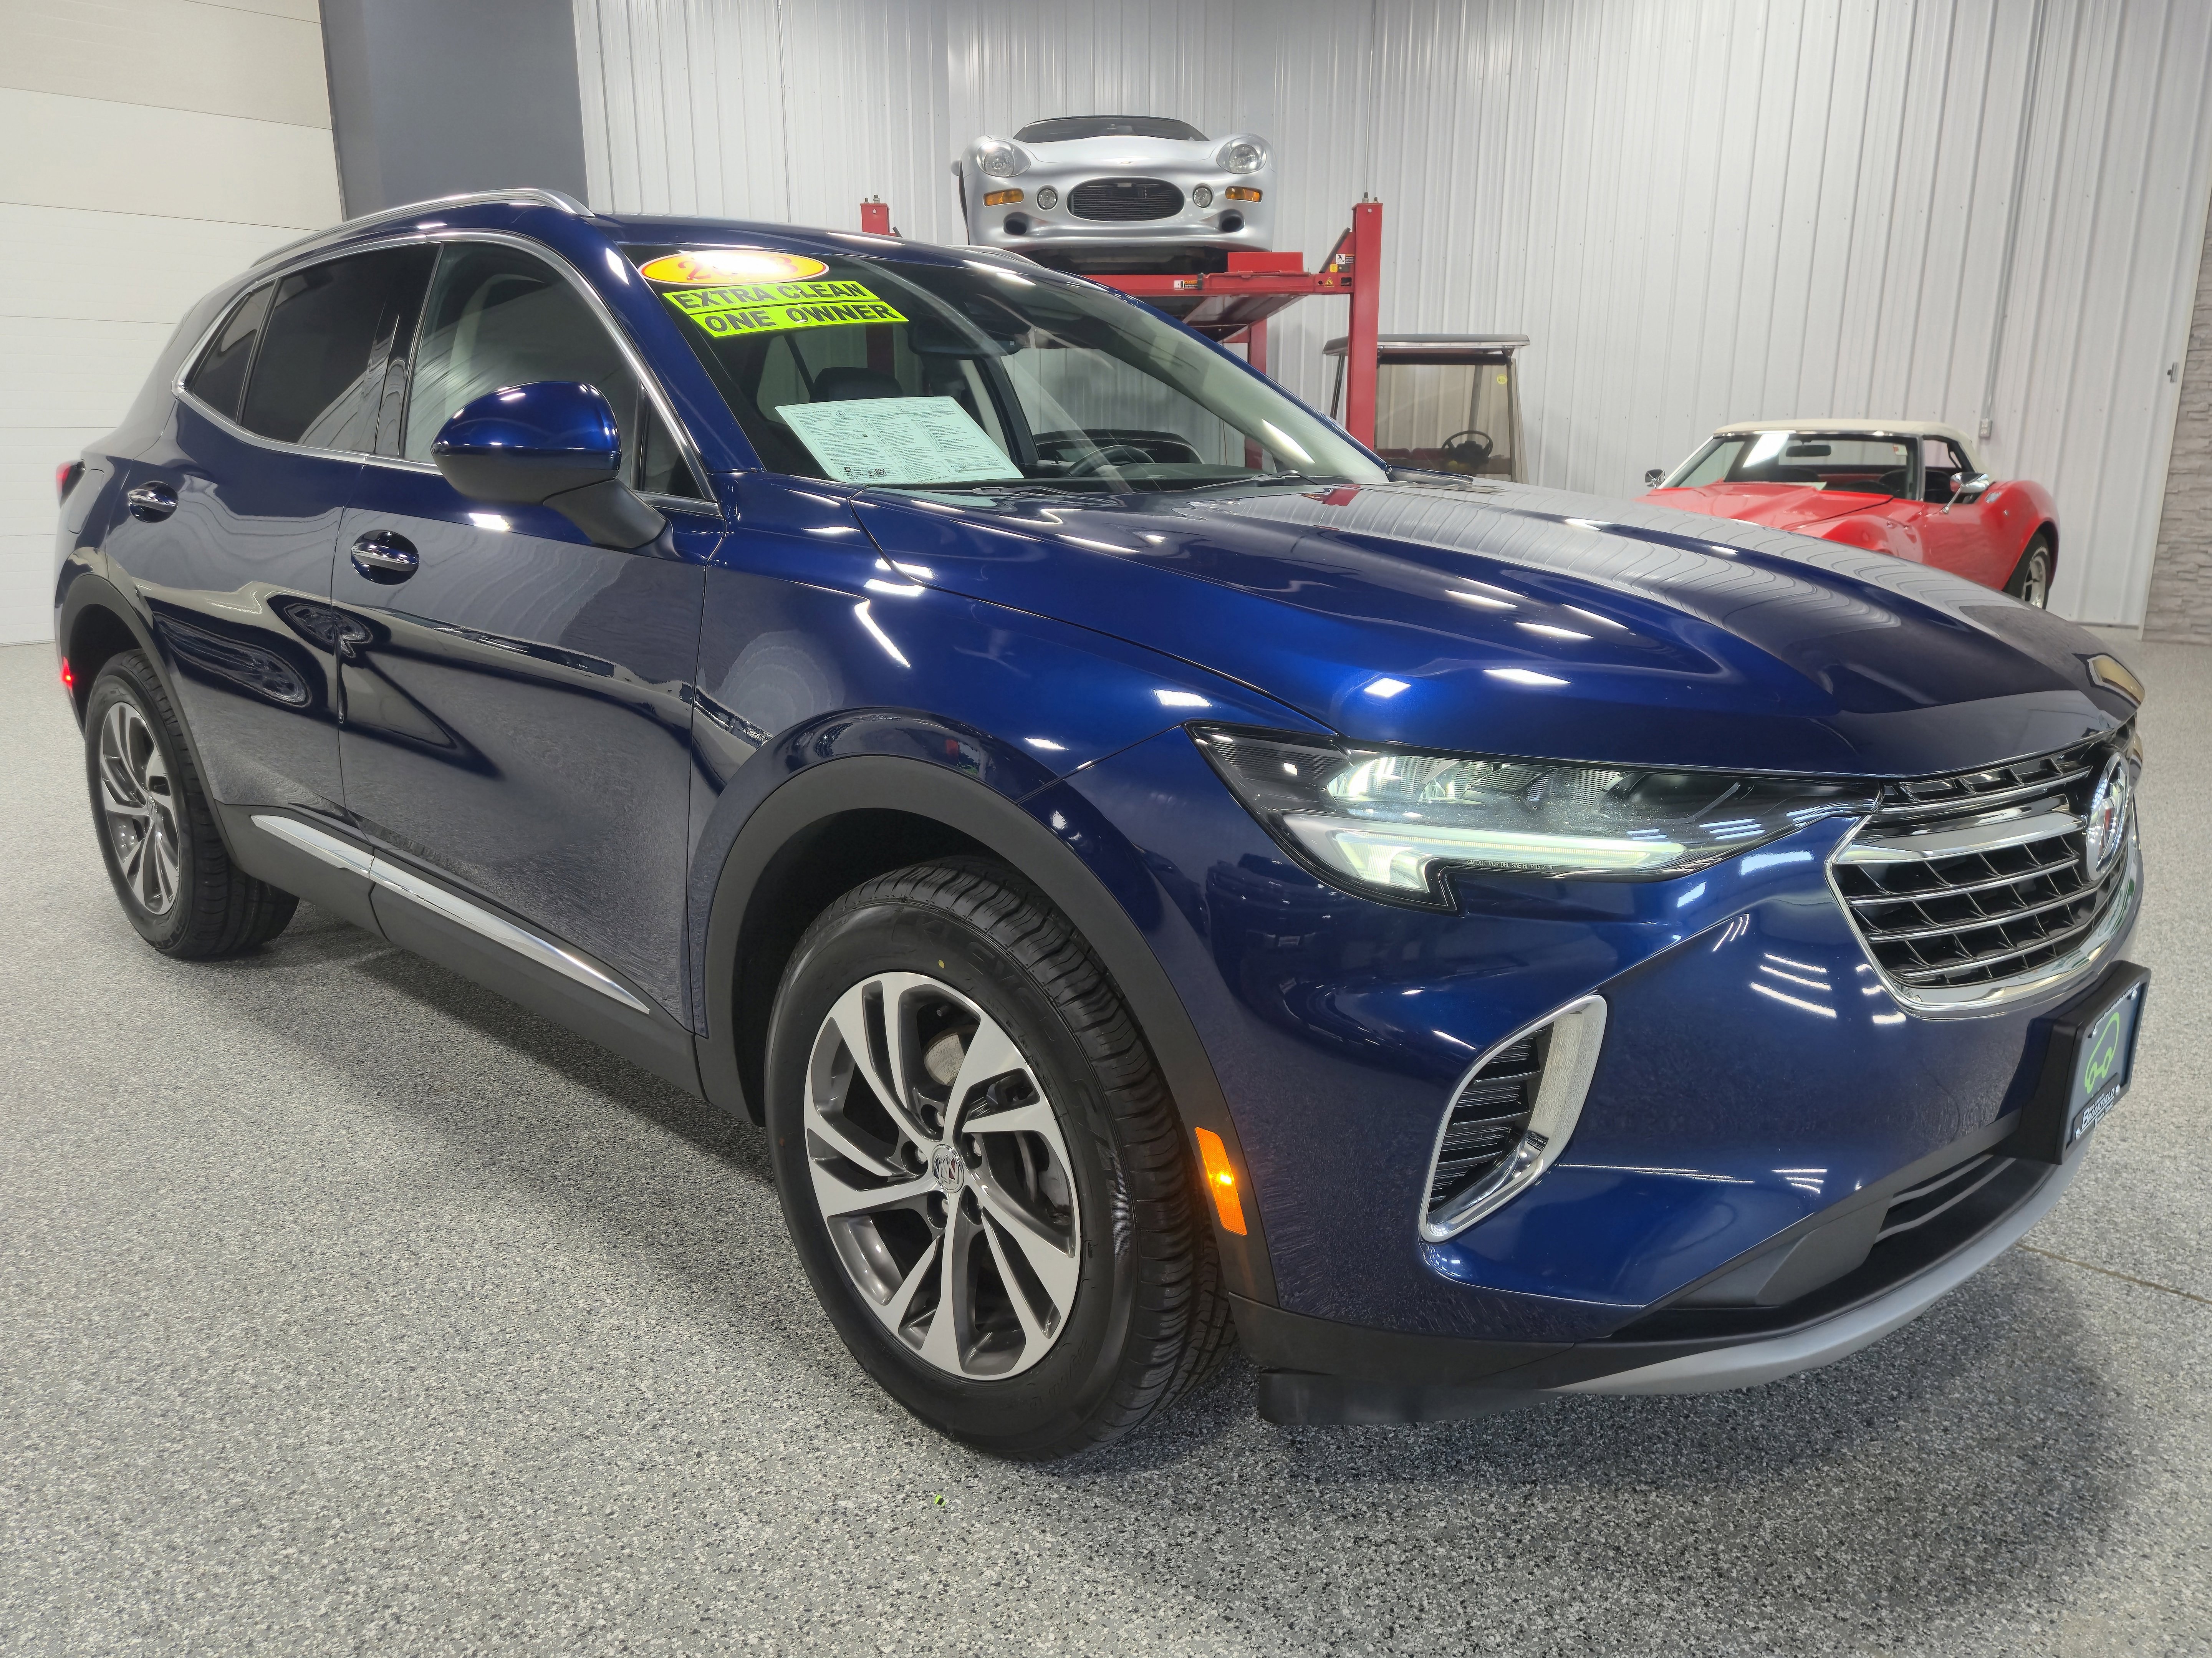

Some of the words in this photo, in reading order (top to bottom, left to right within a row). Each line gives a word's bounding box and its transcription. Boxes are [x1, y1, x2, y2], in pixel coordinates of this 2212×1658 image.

[672, 287, 776, 310] EXTRA
[778, 283, 869, 300] CLEAN
[704, 310, 778, 333] ONE
[789, 303, 899, 324] OWNER
[2081, 1087, 2115, 1130] BROOKFIELD
